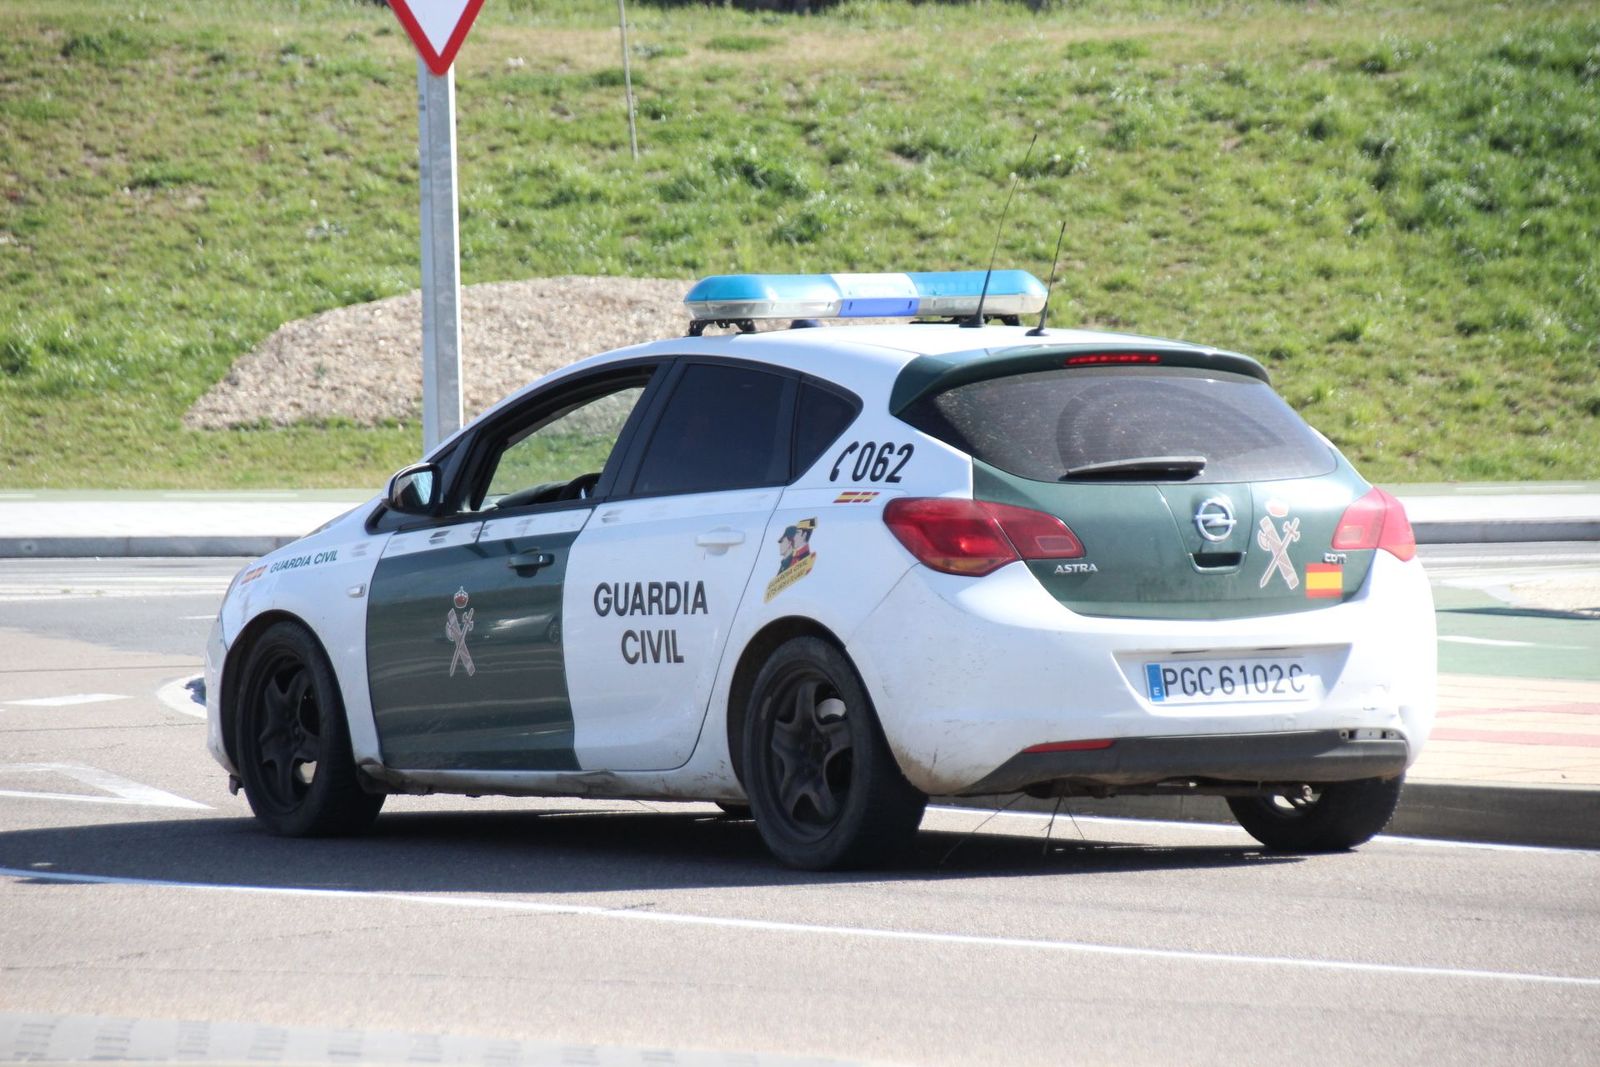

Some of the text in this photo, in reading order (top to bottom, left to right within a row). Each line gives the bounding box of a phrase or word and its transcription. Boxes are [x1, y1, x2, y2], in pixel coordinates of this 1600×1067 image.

[852, 441, 915, 483] 062
[270, 550, 338, 573] GUARDIA CIVIL
[1054, 563, 1098, 574] ASTRA
[593, 580, 709, 617] GUARDIA
[621, 629, 685, 665] CIVIL
[1153, 687, 1161, 696] E
